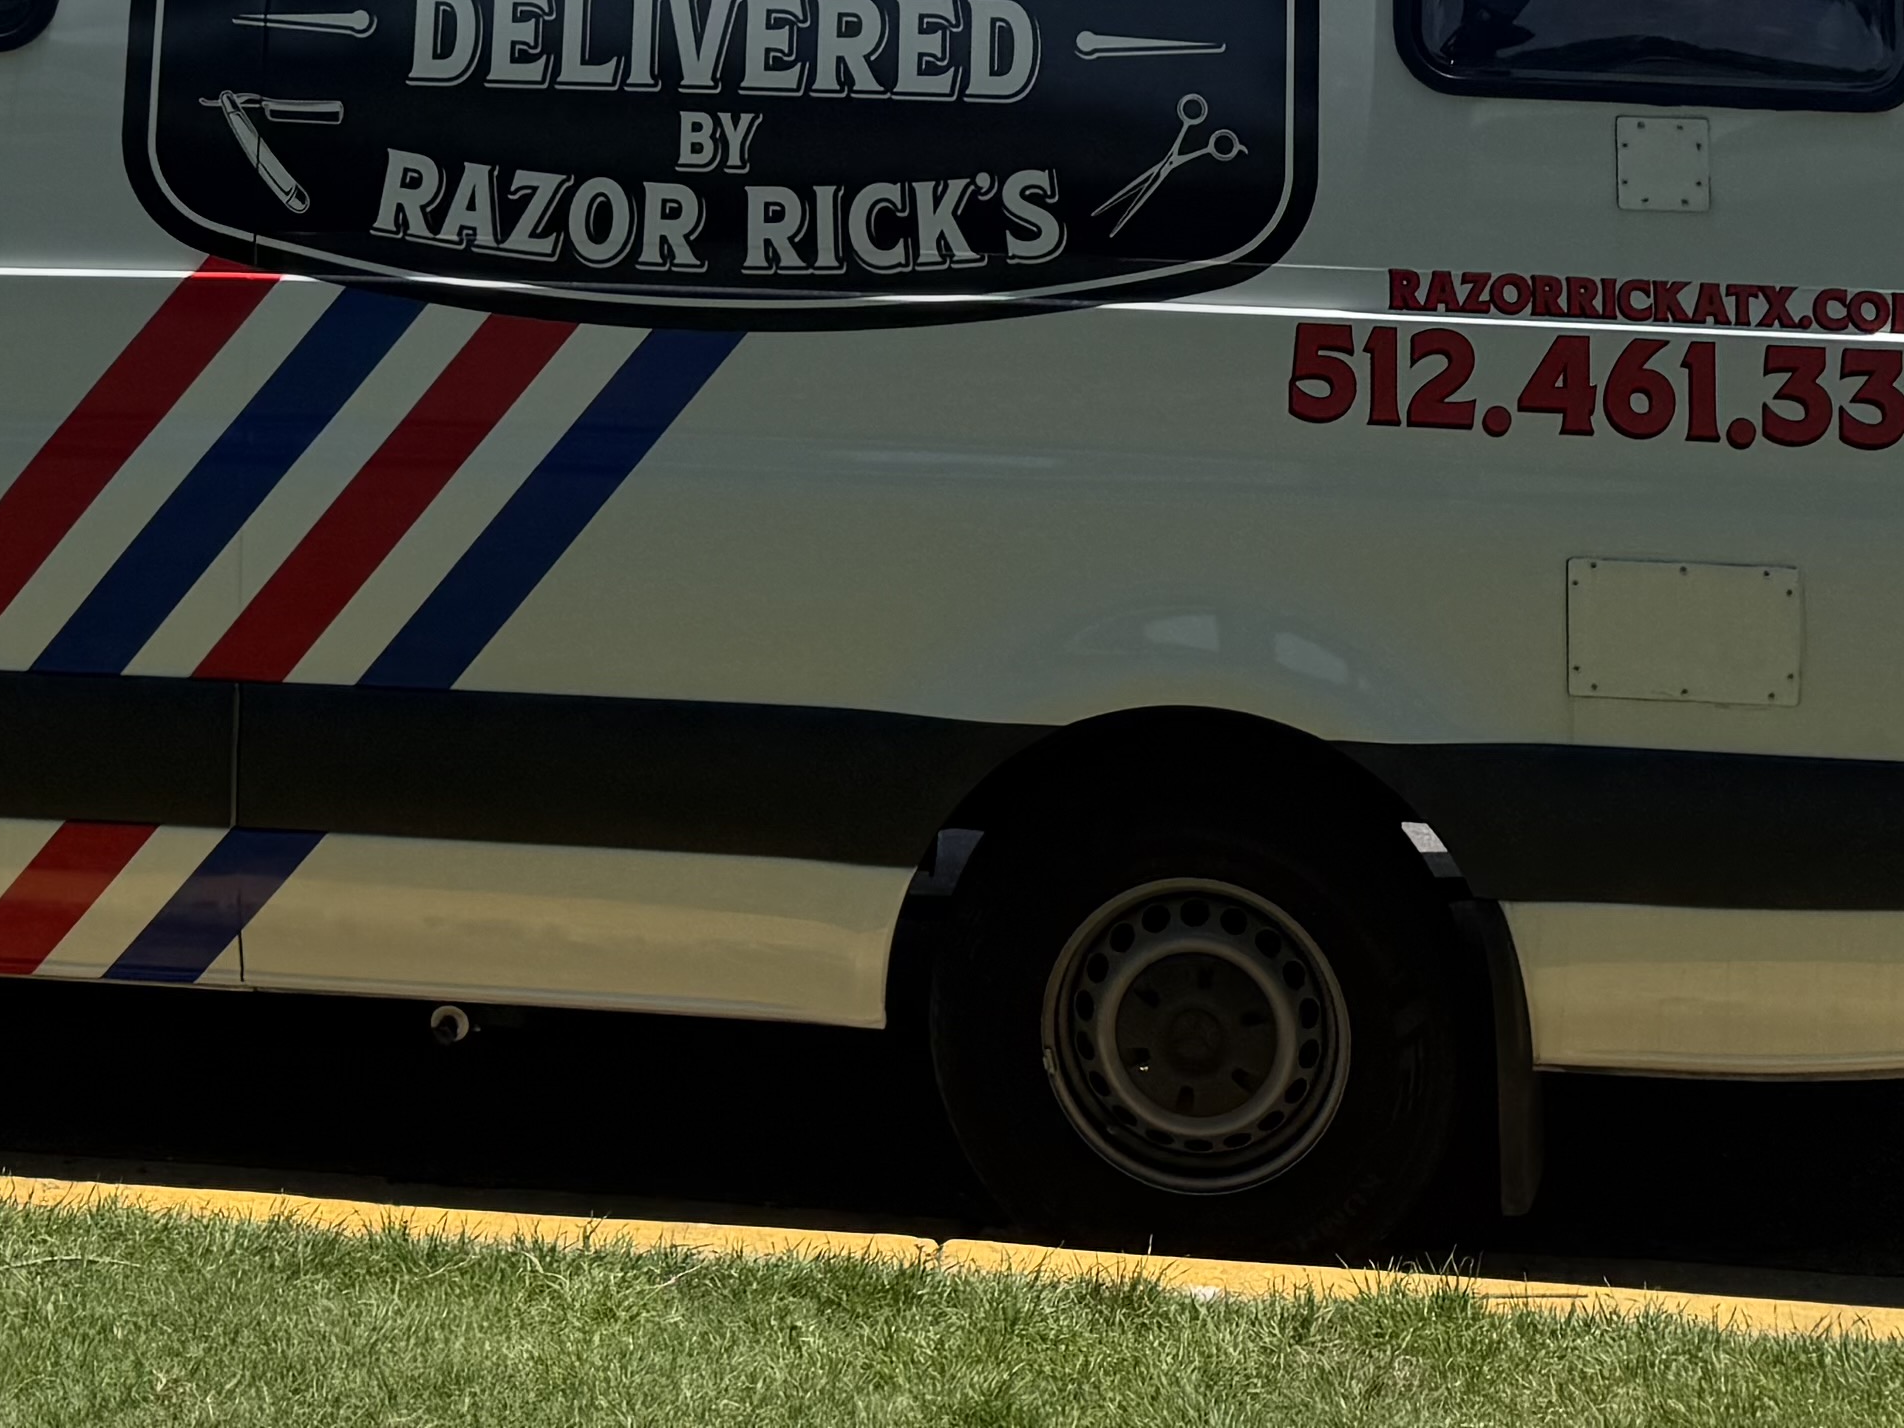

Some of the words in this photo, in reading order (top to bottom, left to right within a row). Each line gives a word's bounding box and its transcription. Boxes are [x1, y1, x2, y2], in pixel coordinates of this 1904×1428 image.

[675, 111, 763, 174] BY
[369, 148, 708, 274] RAZOR
[741, 168, 1067, 275] RICK'S
